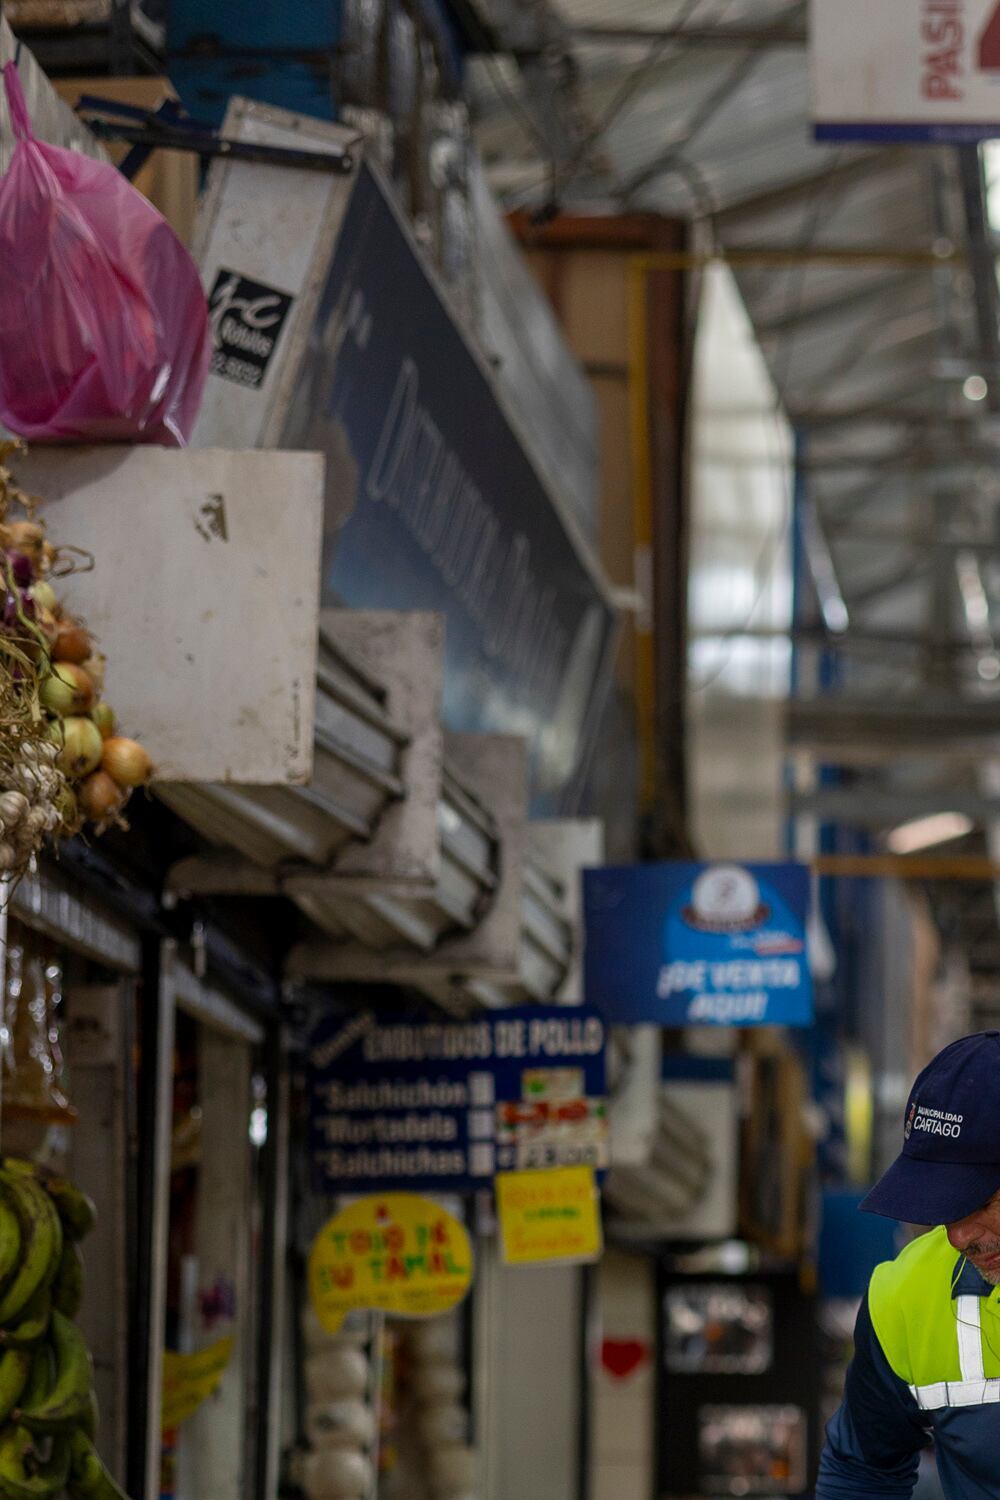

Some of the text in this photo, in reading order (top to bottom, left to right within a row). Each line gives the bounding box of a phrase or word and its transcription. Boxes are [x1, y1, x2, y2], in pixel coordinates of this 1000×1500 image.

[711, 959, 801, 990] VENTA
[495, 1018, 528, 1057] DE
[529, 1016, 603, 1056] POLLO
[913, 1115, 961, 1138] CARTAGO
[369, 1249, 466, 1286] TAMAL
